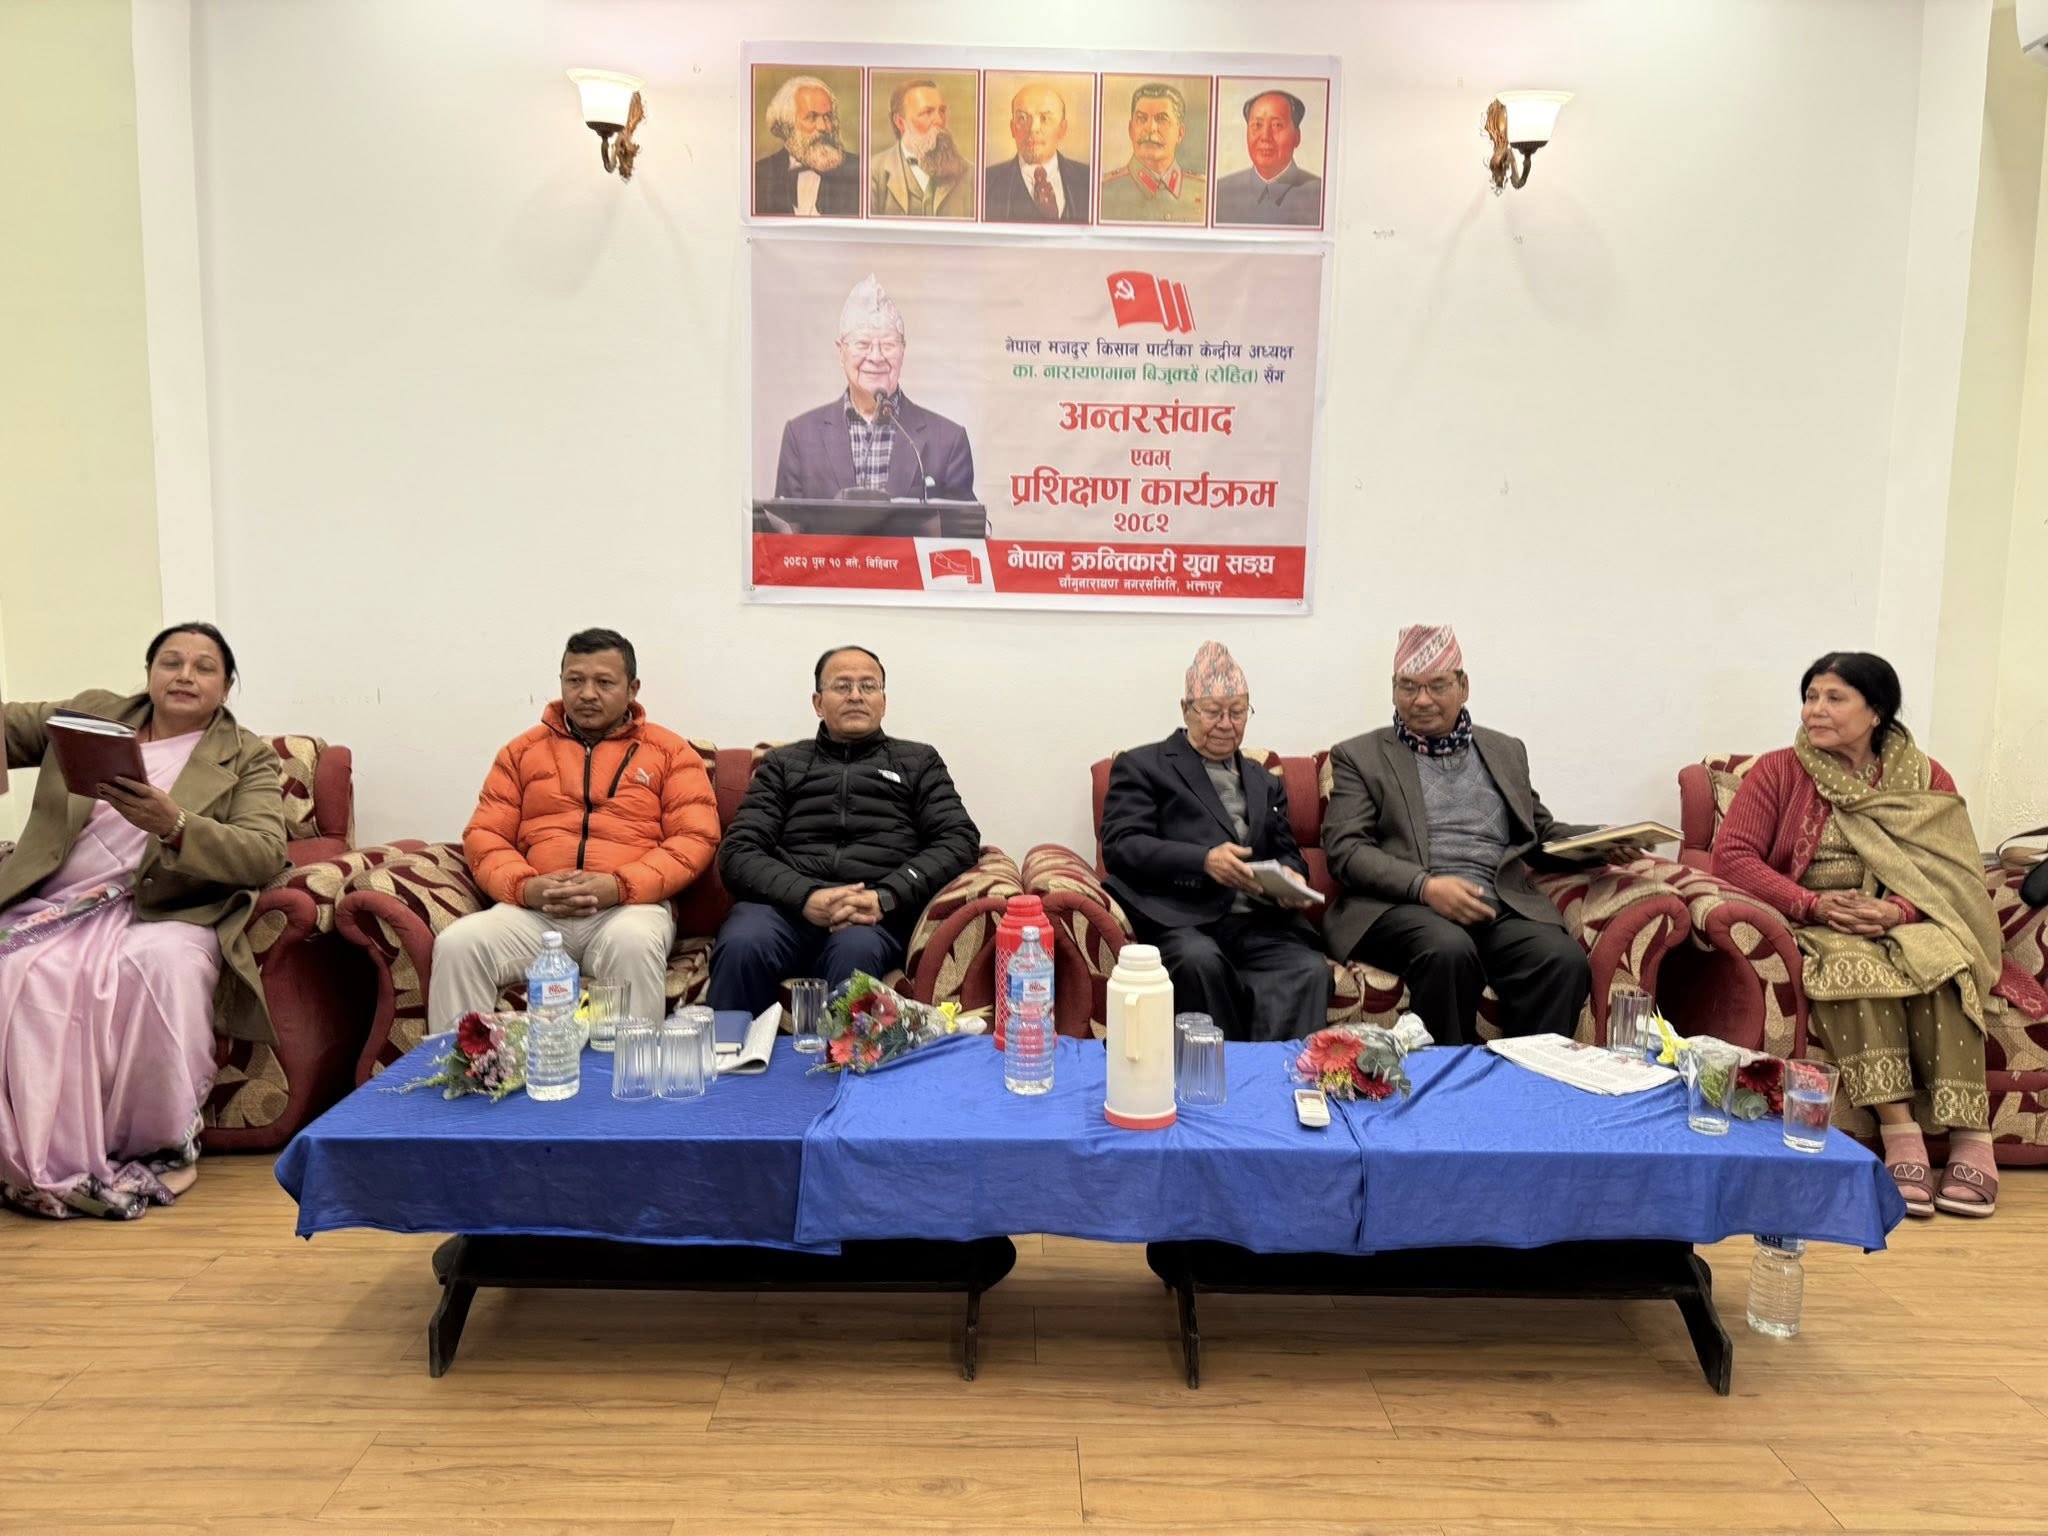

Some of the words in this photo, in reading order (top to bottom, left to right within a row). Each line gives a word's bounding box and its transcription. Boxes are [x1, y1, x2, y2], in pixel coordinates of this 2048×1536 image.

[1005, 336, 1042, 355] नेपाल
[1048, 341, 1090, 359] मजदुर
[1097, 337, 1140, 357] किसान
[1146, 339, 1193, 357] पार्टीका
[1200, 340, 1242, 360] केन्द्रीय
[1249, 344, 1294, 361] अध्यक्ष
[1012, 364, 1037, 378] का.
[1043, 364, 1136, 380] नारायणमान
[1205, 364, 1258, 383] (रोहित)
[1264, 363, 1285, 384] सँग
[1058, 398, 1236, 435] अन्तरसंवाद
[1130, 449, 1171, 470] एवम्
[1010, 466, 1132, 508] प्रशिक्षण
[1141, 471, 1278, 508] कार्यक्रम
[1113, 512, 1169, 533] २०८२
[829, 557, 841, 569] १०
[1008, 544, 1065, 570] नेपाल
[1183, 554, 1219, 578] युवा
[1225, 554, 1275, 578] सङ्घ
[1186, 580, 1223, 595] भक्तपुर
